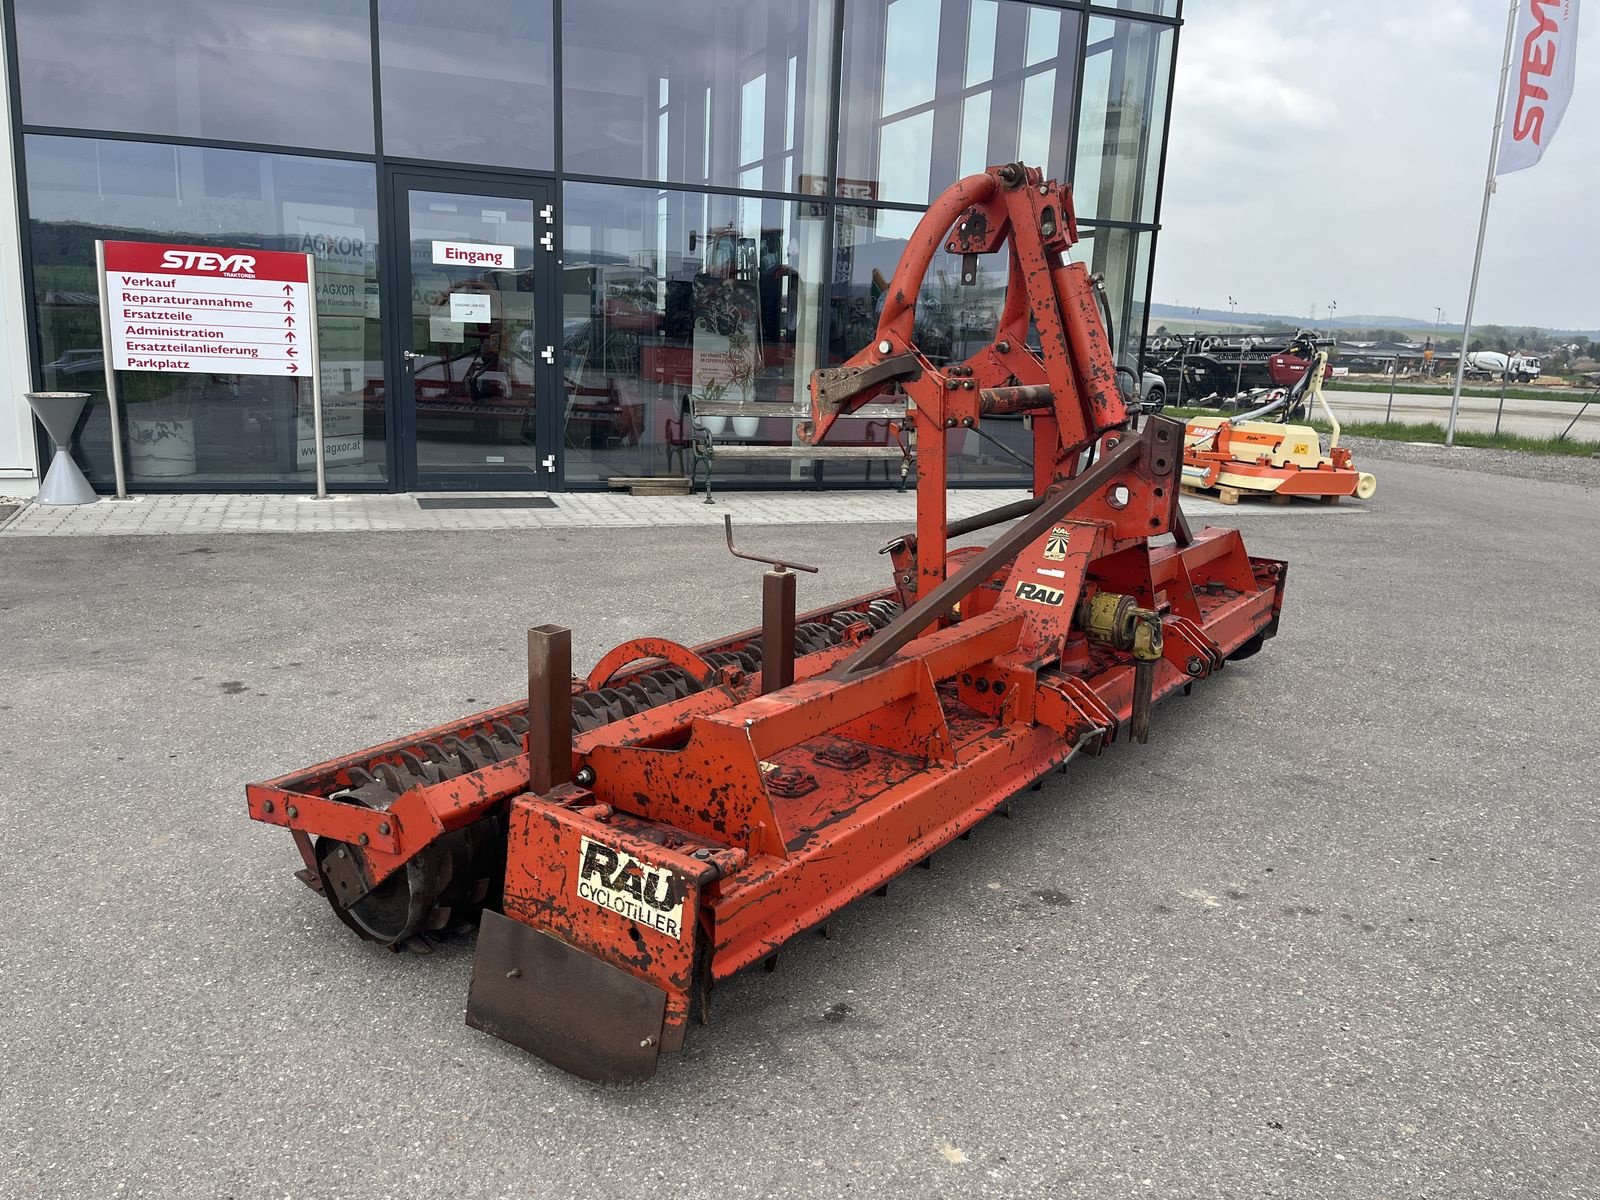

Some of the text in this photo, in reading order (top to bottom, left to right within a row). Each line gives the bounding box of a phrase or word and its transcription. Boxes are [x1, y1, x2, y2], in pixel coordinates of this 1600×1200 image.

[1513, 0, 1561, 145] STEY
[160, 250, 256, 273] STEYR
[445, 247, 503, 266] Eingang
[121, 276, 177, 288] Verkauf
[322, 284, 354, 296] AGXOR
[122, 292, 253, 308] Reparaturannahme
[123, 309, 193, 321] Ersatzteile
[126, 326, 224, 338] Administration
[126, 342, 258, 358] Ersatzteilanlieferung
[127, 358, 190, 370] Parkplatz
[1016, 583, 1064, 605] RAU
[581, 841, 681, 913] RAU
